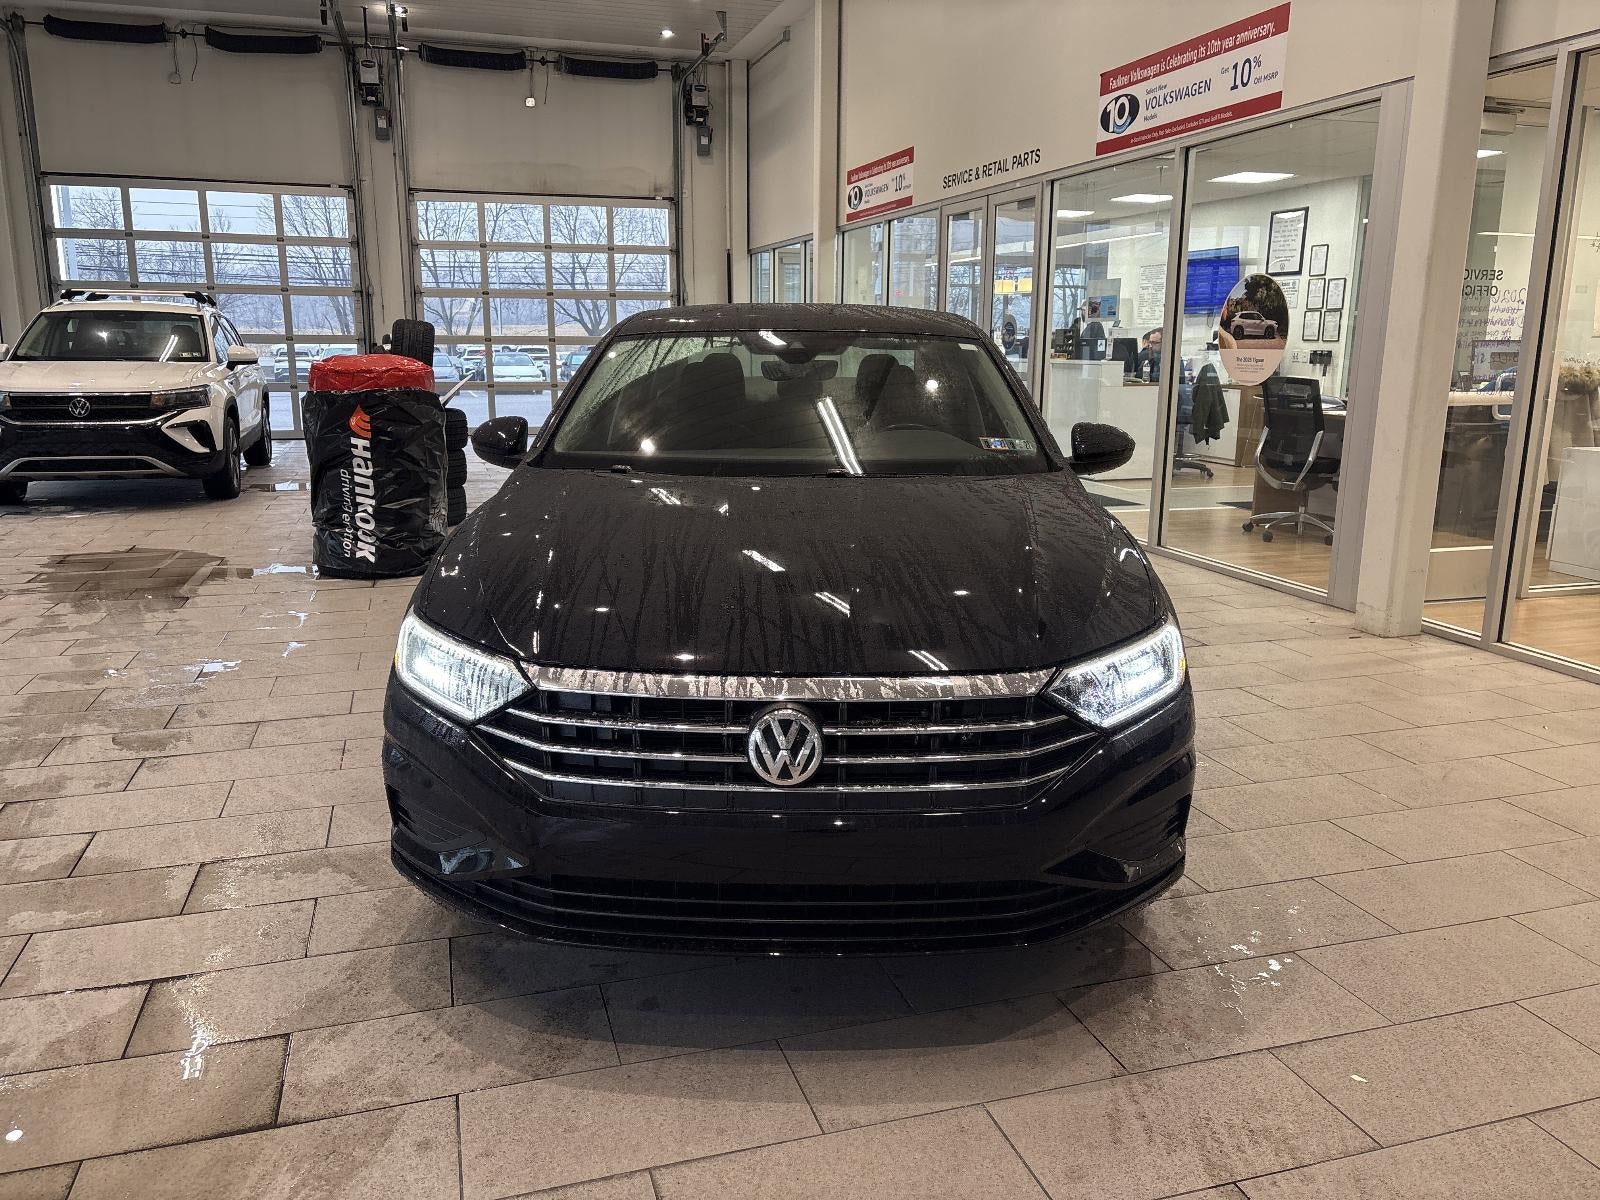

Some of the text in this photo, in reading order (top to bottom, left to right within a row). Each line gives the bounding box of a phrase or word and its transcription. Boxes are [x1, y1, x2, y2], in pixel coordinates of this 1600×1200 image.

[1109, 74, 1130, 91] Faulkner
[1130, 63, 1160, 80] Volkswagen
[1160, 59, 1166, 72] is
[1166, 48, 1198, 70] Celebrating
[1206, 37, 1221, 55] 10th
[1221, 34, 1236, 53] year
[1263, 71, 1279, 83] MSRP
[1145, 77, 1212, 111] VOLKSWAGEN
[942, 148, 1041, 189] SERVICE & RETAIL PARTS
[340, 468, 353, 513] driving
[350, 437, 376, 564] Hankook
